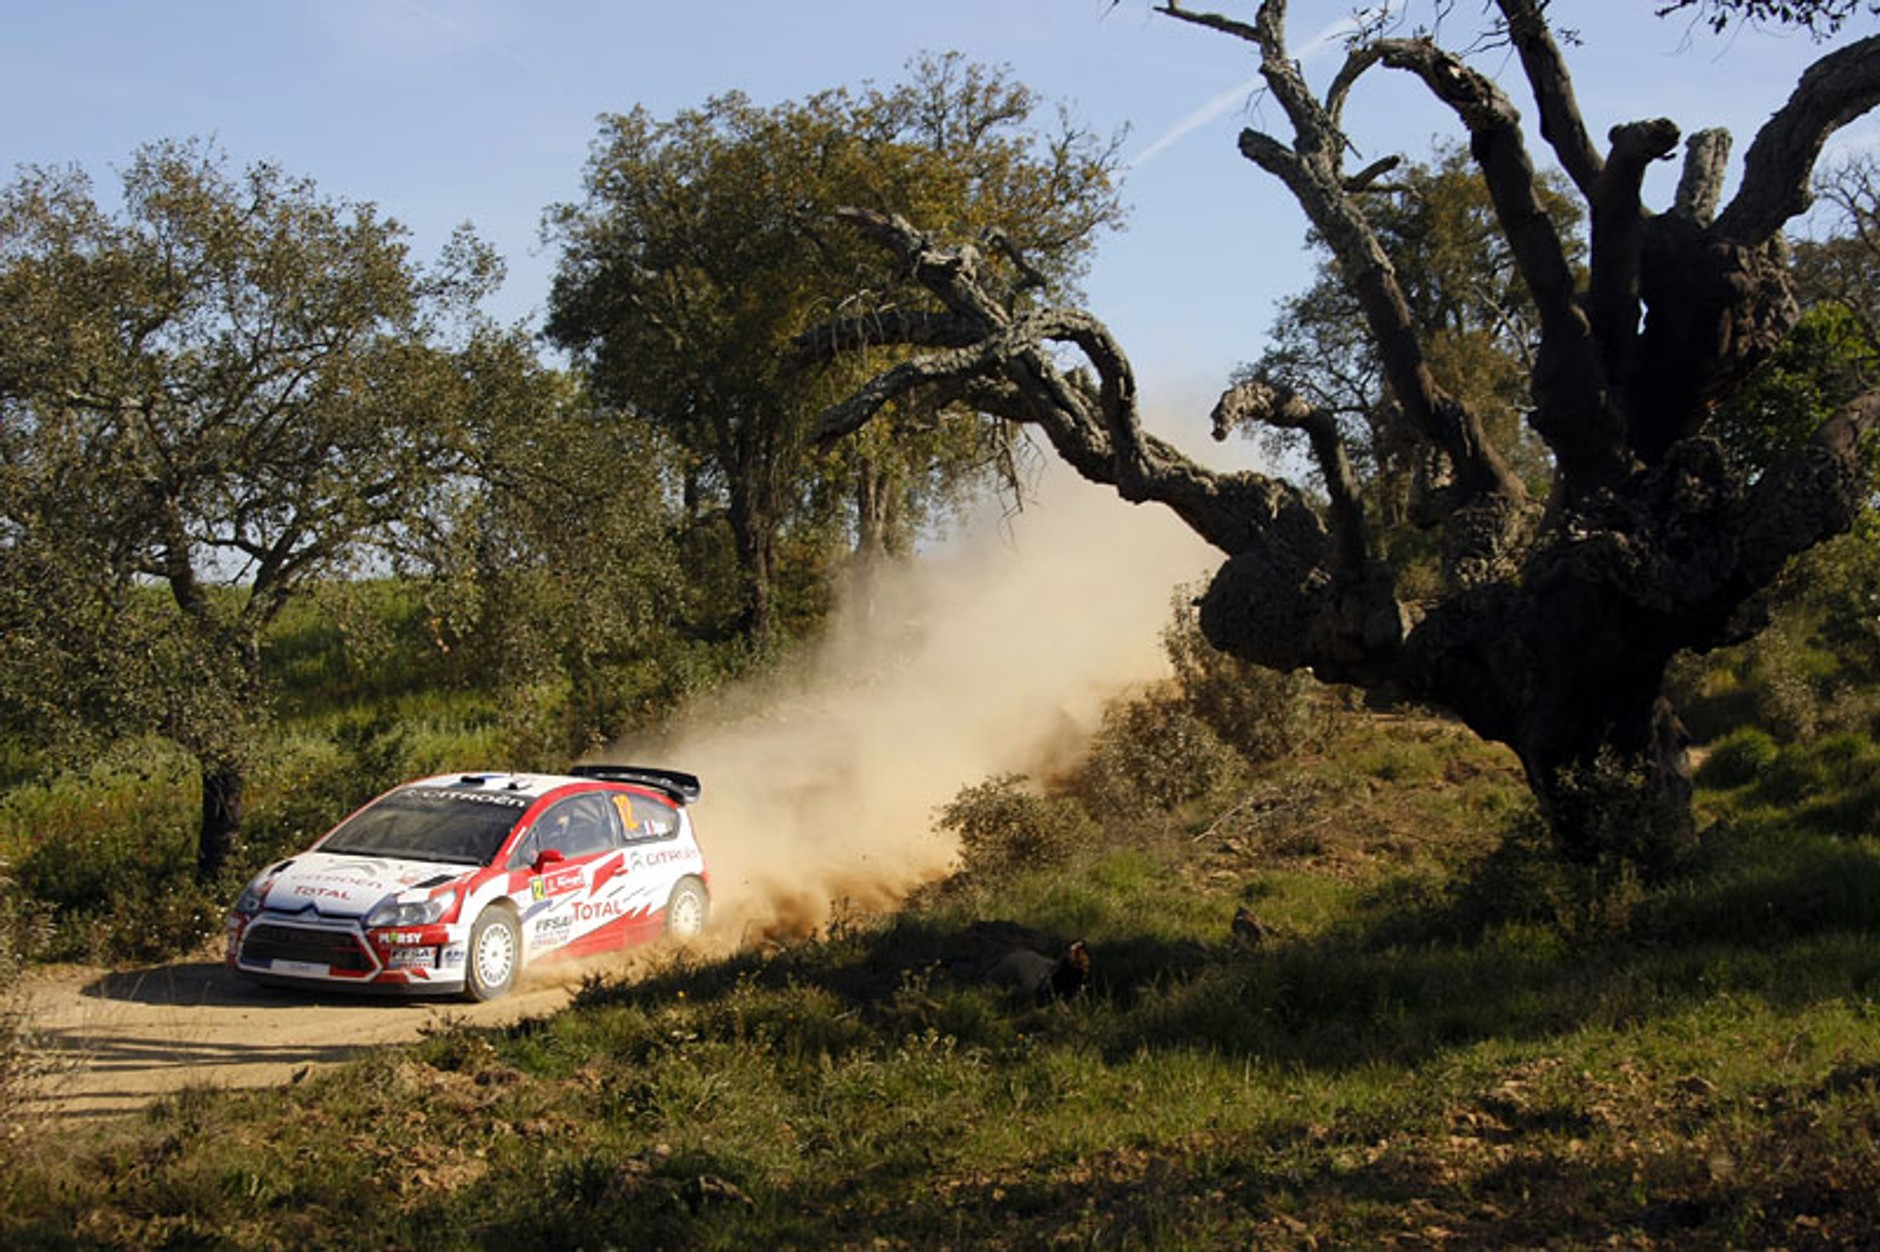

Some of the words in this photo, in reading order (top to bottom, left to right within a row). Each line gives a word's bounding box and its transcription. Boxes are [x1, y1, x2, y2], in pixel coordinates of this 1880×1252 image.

[612, 794, 640, 829] 12
[294, 885, 351, 900] TOTAL
[571, 900, 623, 922] TOTAL
